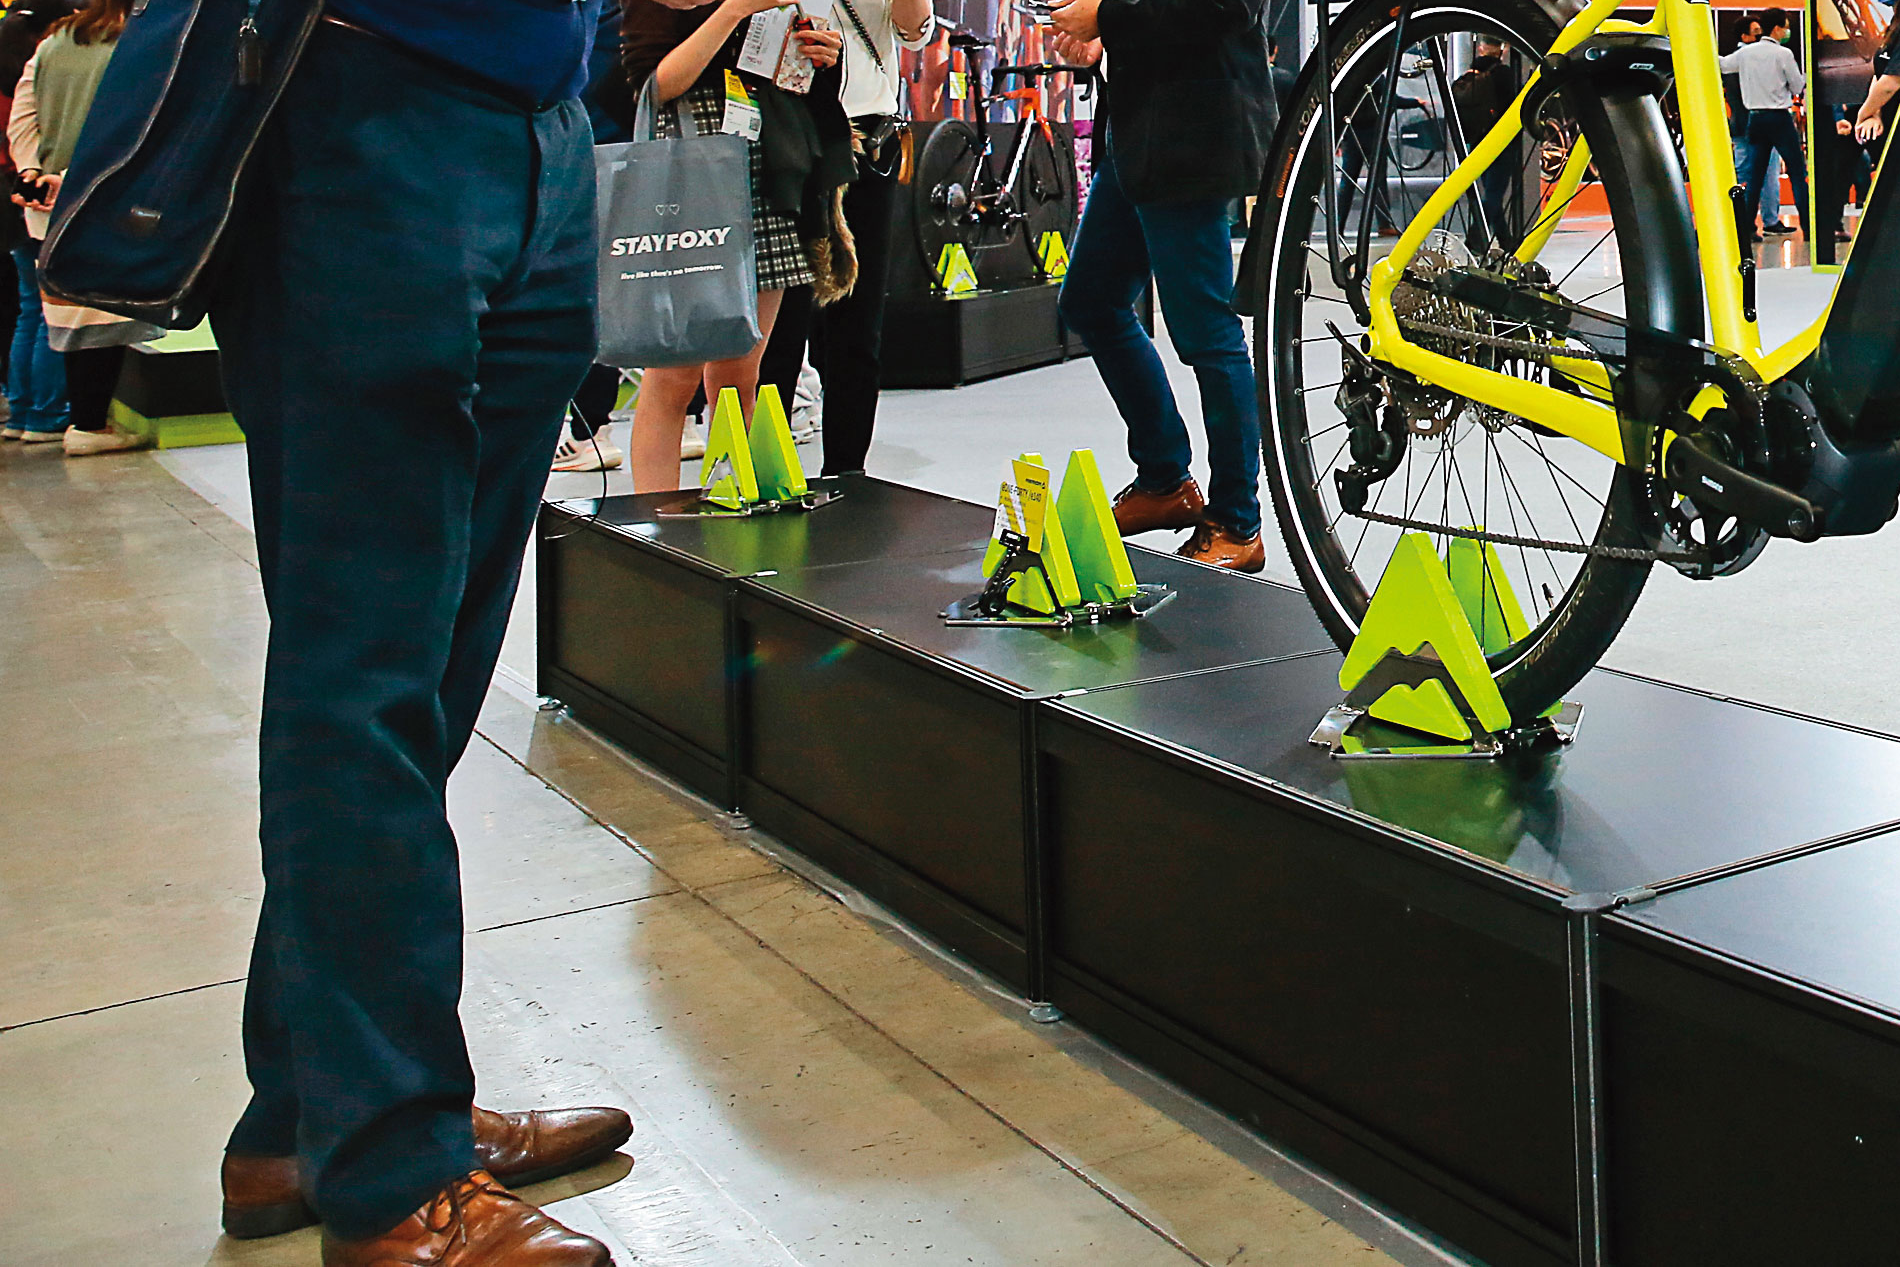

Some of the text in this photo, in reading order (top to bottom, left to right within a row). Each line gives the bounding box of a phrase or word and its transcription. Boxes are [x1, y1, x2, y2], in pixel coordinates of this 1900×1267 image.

[610, 227, 731, 256] STAYFOXY
[621, 272, 635, 280] live
[636, 271, 649, 279] like
[684, 264, 724, 274] tomorrow.
